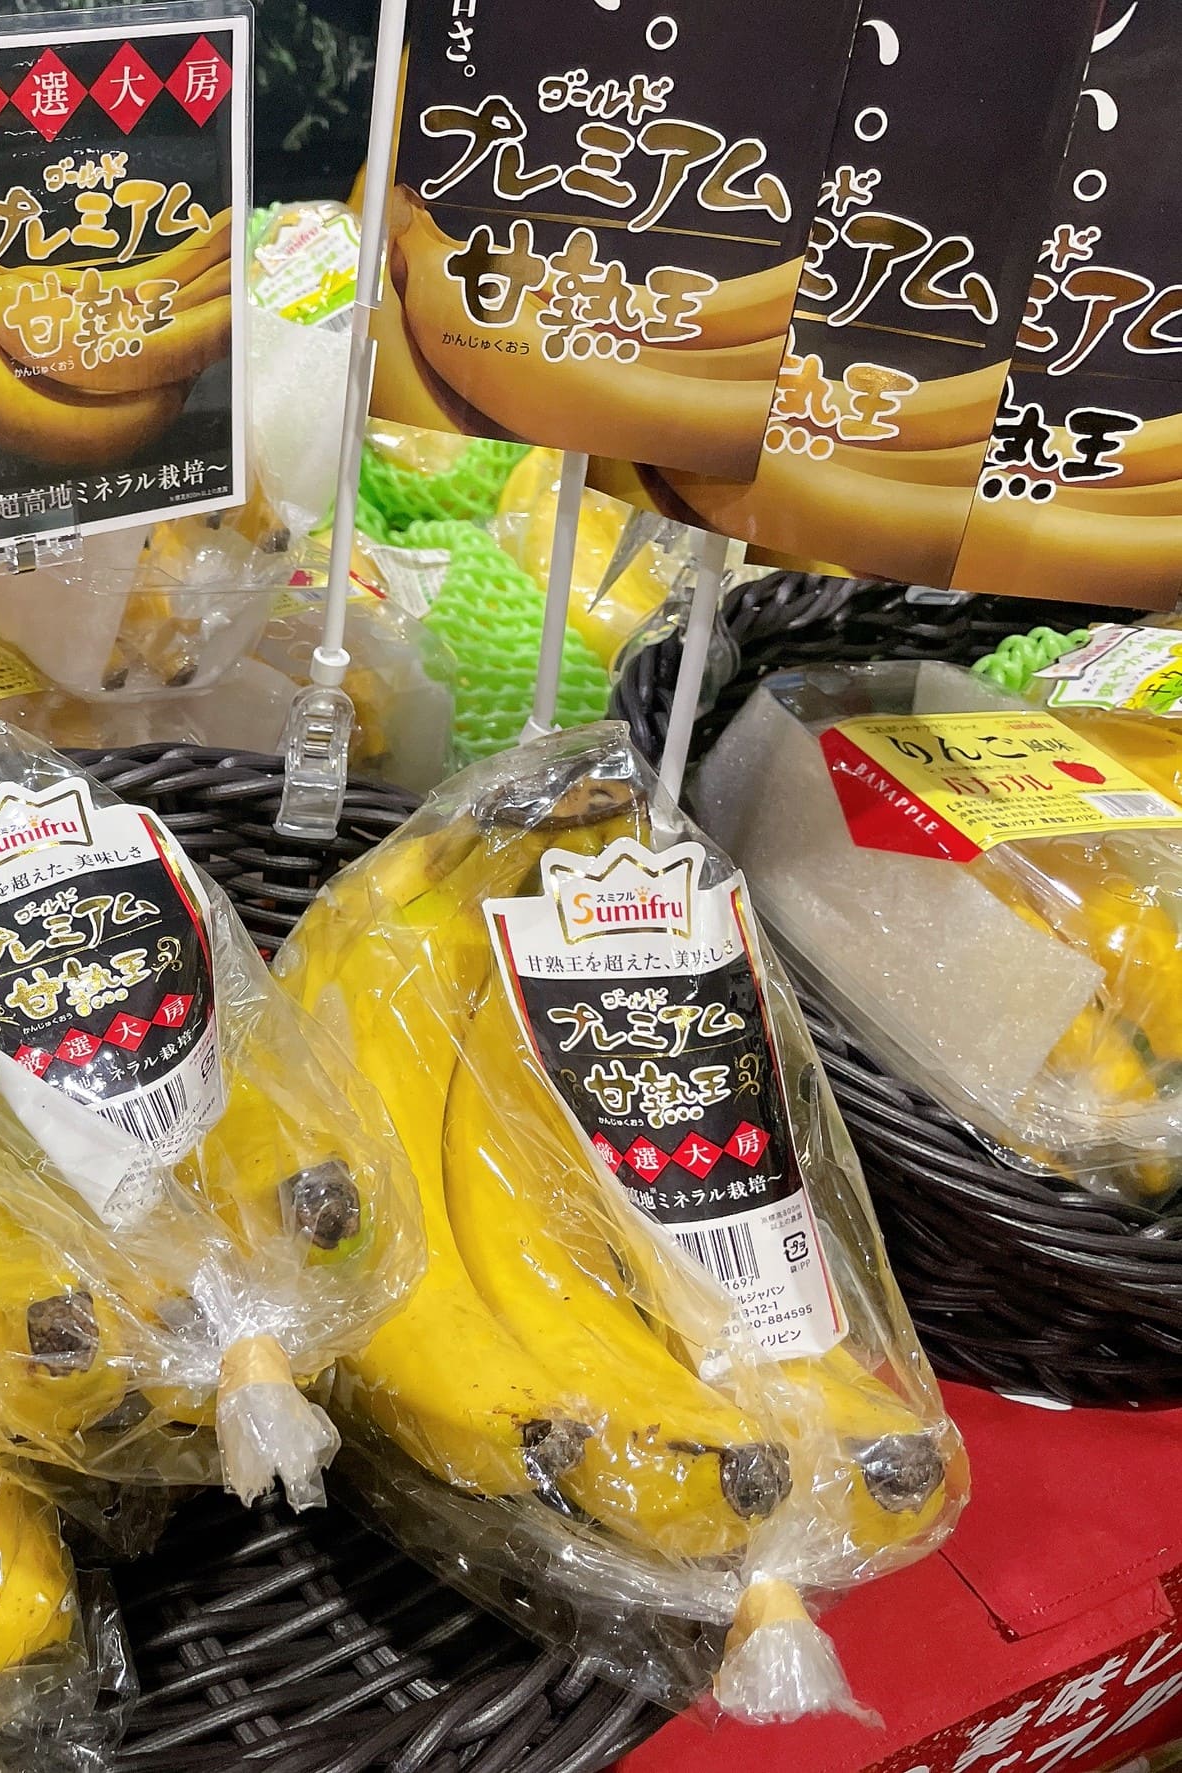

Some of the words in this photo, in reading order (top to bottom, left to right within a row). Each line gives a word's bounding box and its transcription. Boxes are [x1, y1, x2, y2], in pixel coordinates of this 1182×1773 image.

[539, 69, 674, 125] ゴールド
[44, 152, 128, 192] ゴールド
[420, 95, 792, 232] プレミアム
[817, 166, 882, 216] ド
[1037, 225, 1101, 272] ド
[444, 219, 720, 365] 甘熟王
[3, 268, 180, 369] 甘熟王
[442, 331, 531, 356] かんじゅくおう
[14, 359, 75, 378] かんじゅくおう
[853, 762, 939, 836] BANAPPLE
[14, 887, 78, 925] ゴールド
[572, 891, 683, 925] Sumifru
[596, 892, 636, 903] スミフル
[5, 948, 153, 1020] 甘熟王
[601, 987, 669, 1012] ゴールド
[547, 1001, 746, 1057] プレミアム
[584, 1060, 731, 1130] 甘熟王
[732, 1304, 813, 1335] 020-884595
